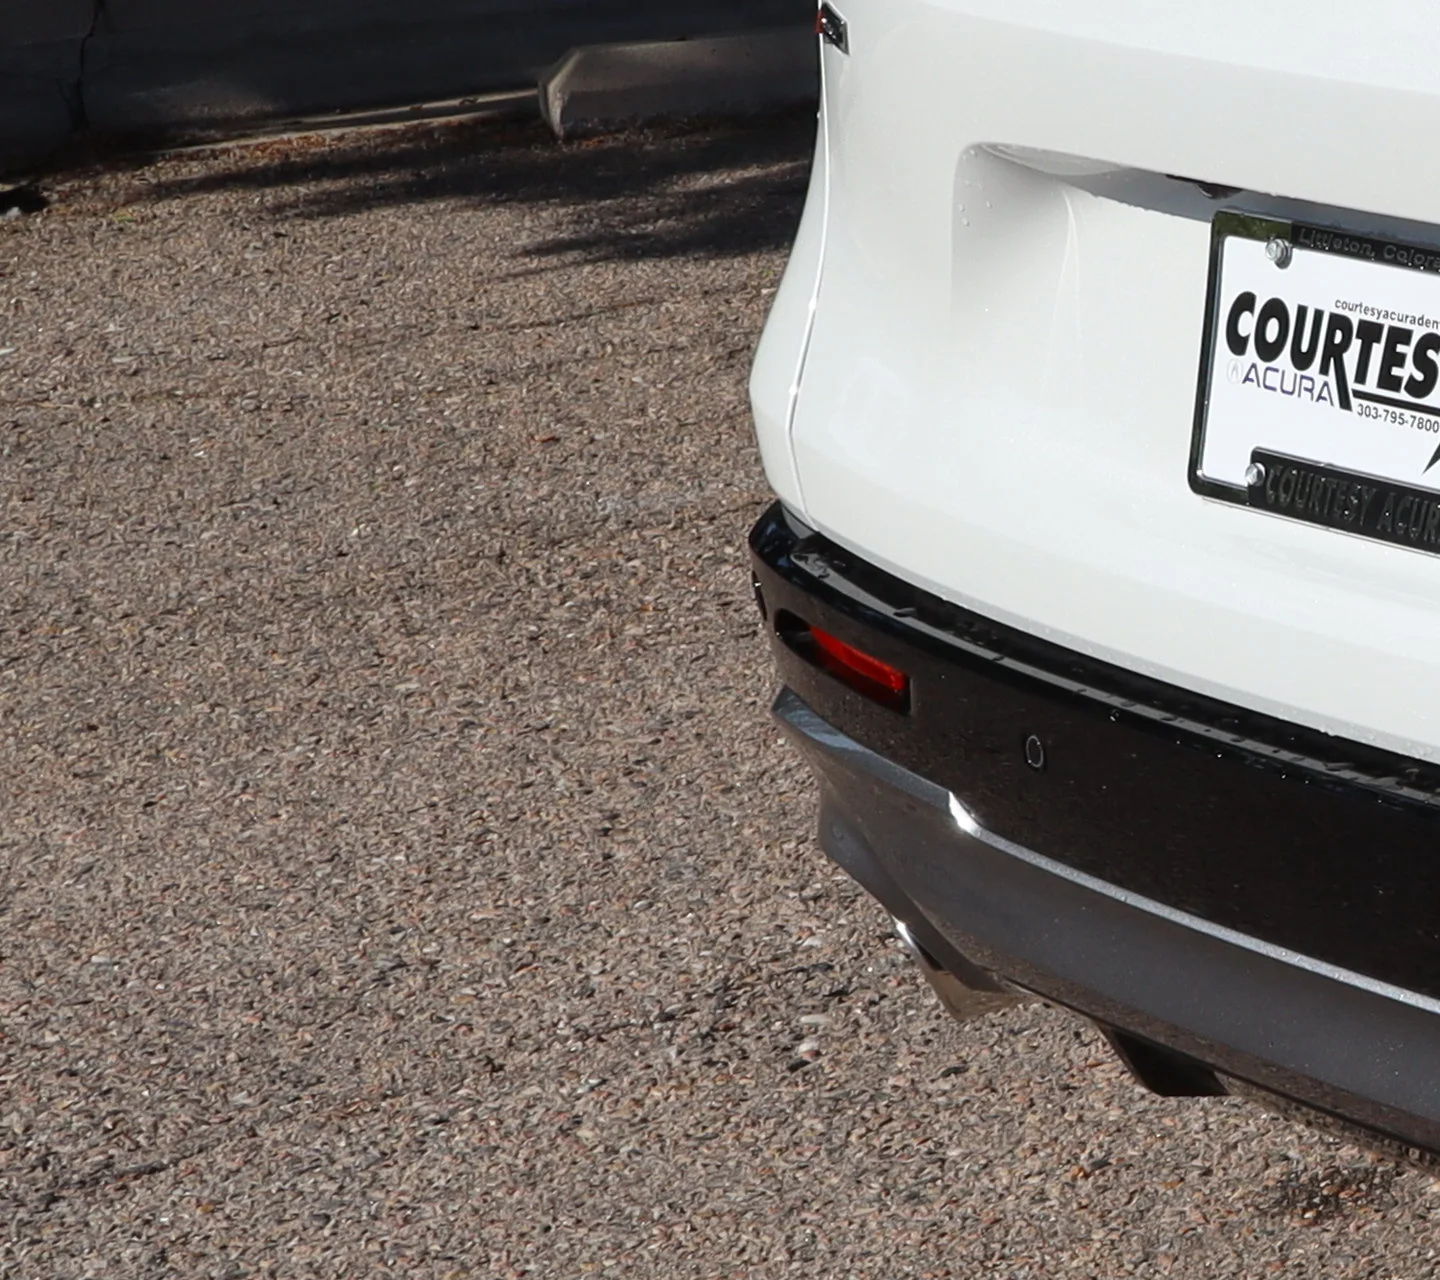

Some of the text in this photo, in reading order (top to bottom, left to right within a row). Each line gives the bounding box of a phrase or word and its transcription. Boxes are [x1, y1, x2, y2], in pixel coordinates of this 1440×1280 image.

[1300, 228, 1376, 257] Littleton,
[1241, 362, 1335, 408] ACURA
[1356, 403, 1440, 434] 303-795-7800
[1265, 464, 1378, 526] COURTESY
